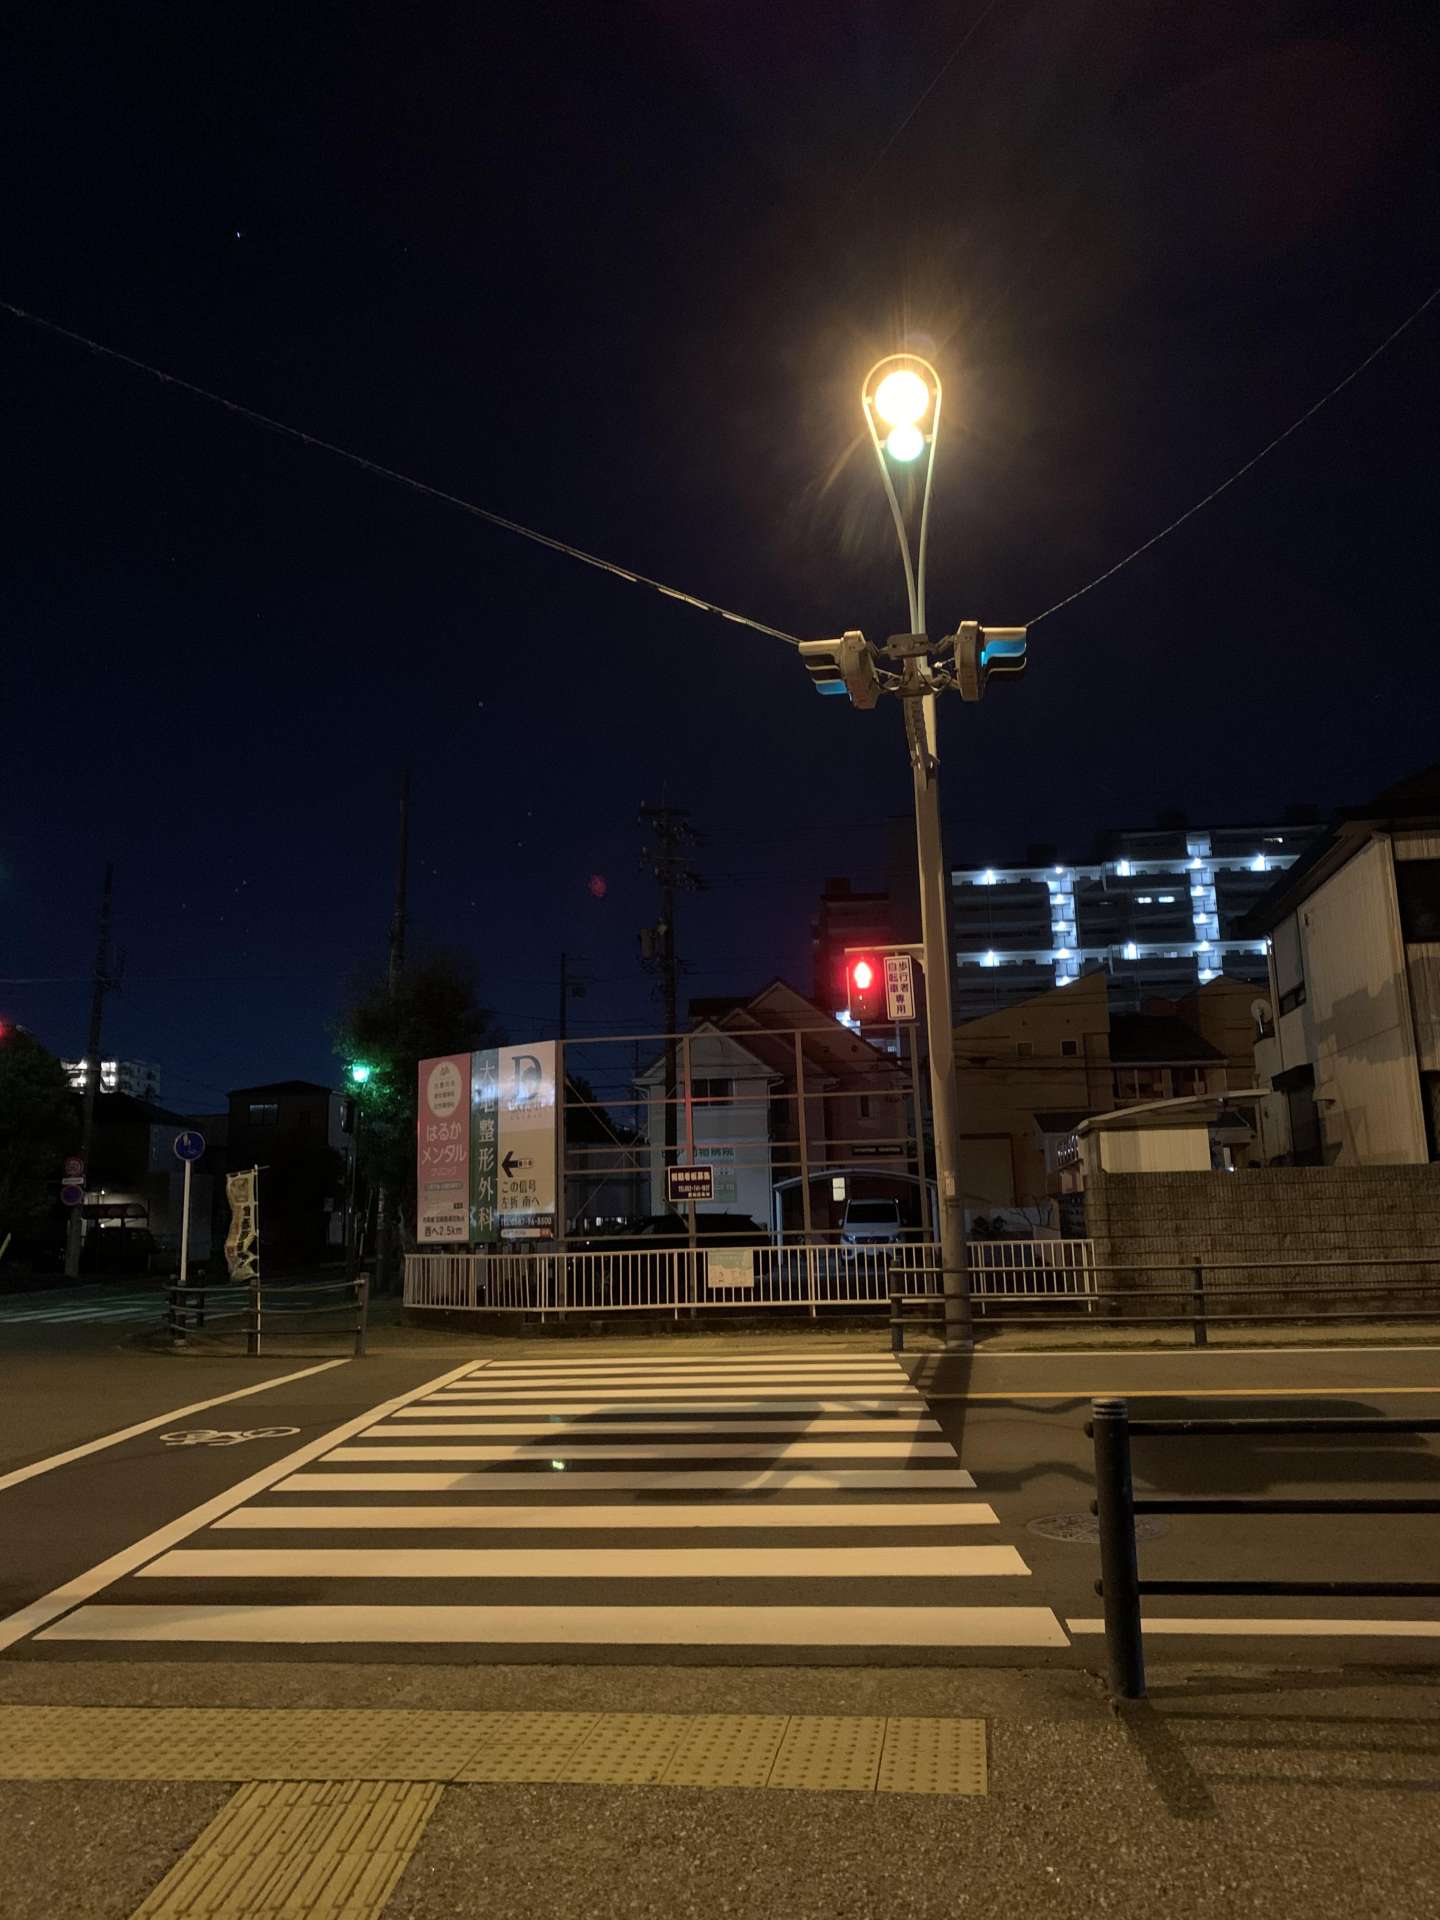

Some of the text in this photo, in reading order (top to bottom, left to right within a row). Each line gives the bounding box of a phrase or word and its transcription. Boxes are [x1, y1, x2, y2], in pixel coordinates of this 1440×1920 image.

[426, 1121, 462, 1141] はるか
[421, 1143, 467, 1165] メンタル
[501, 1179, 536, 1193] この信号
